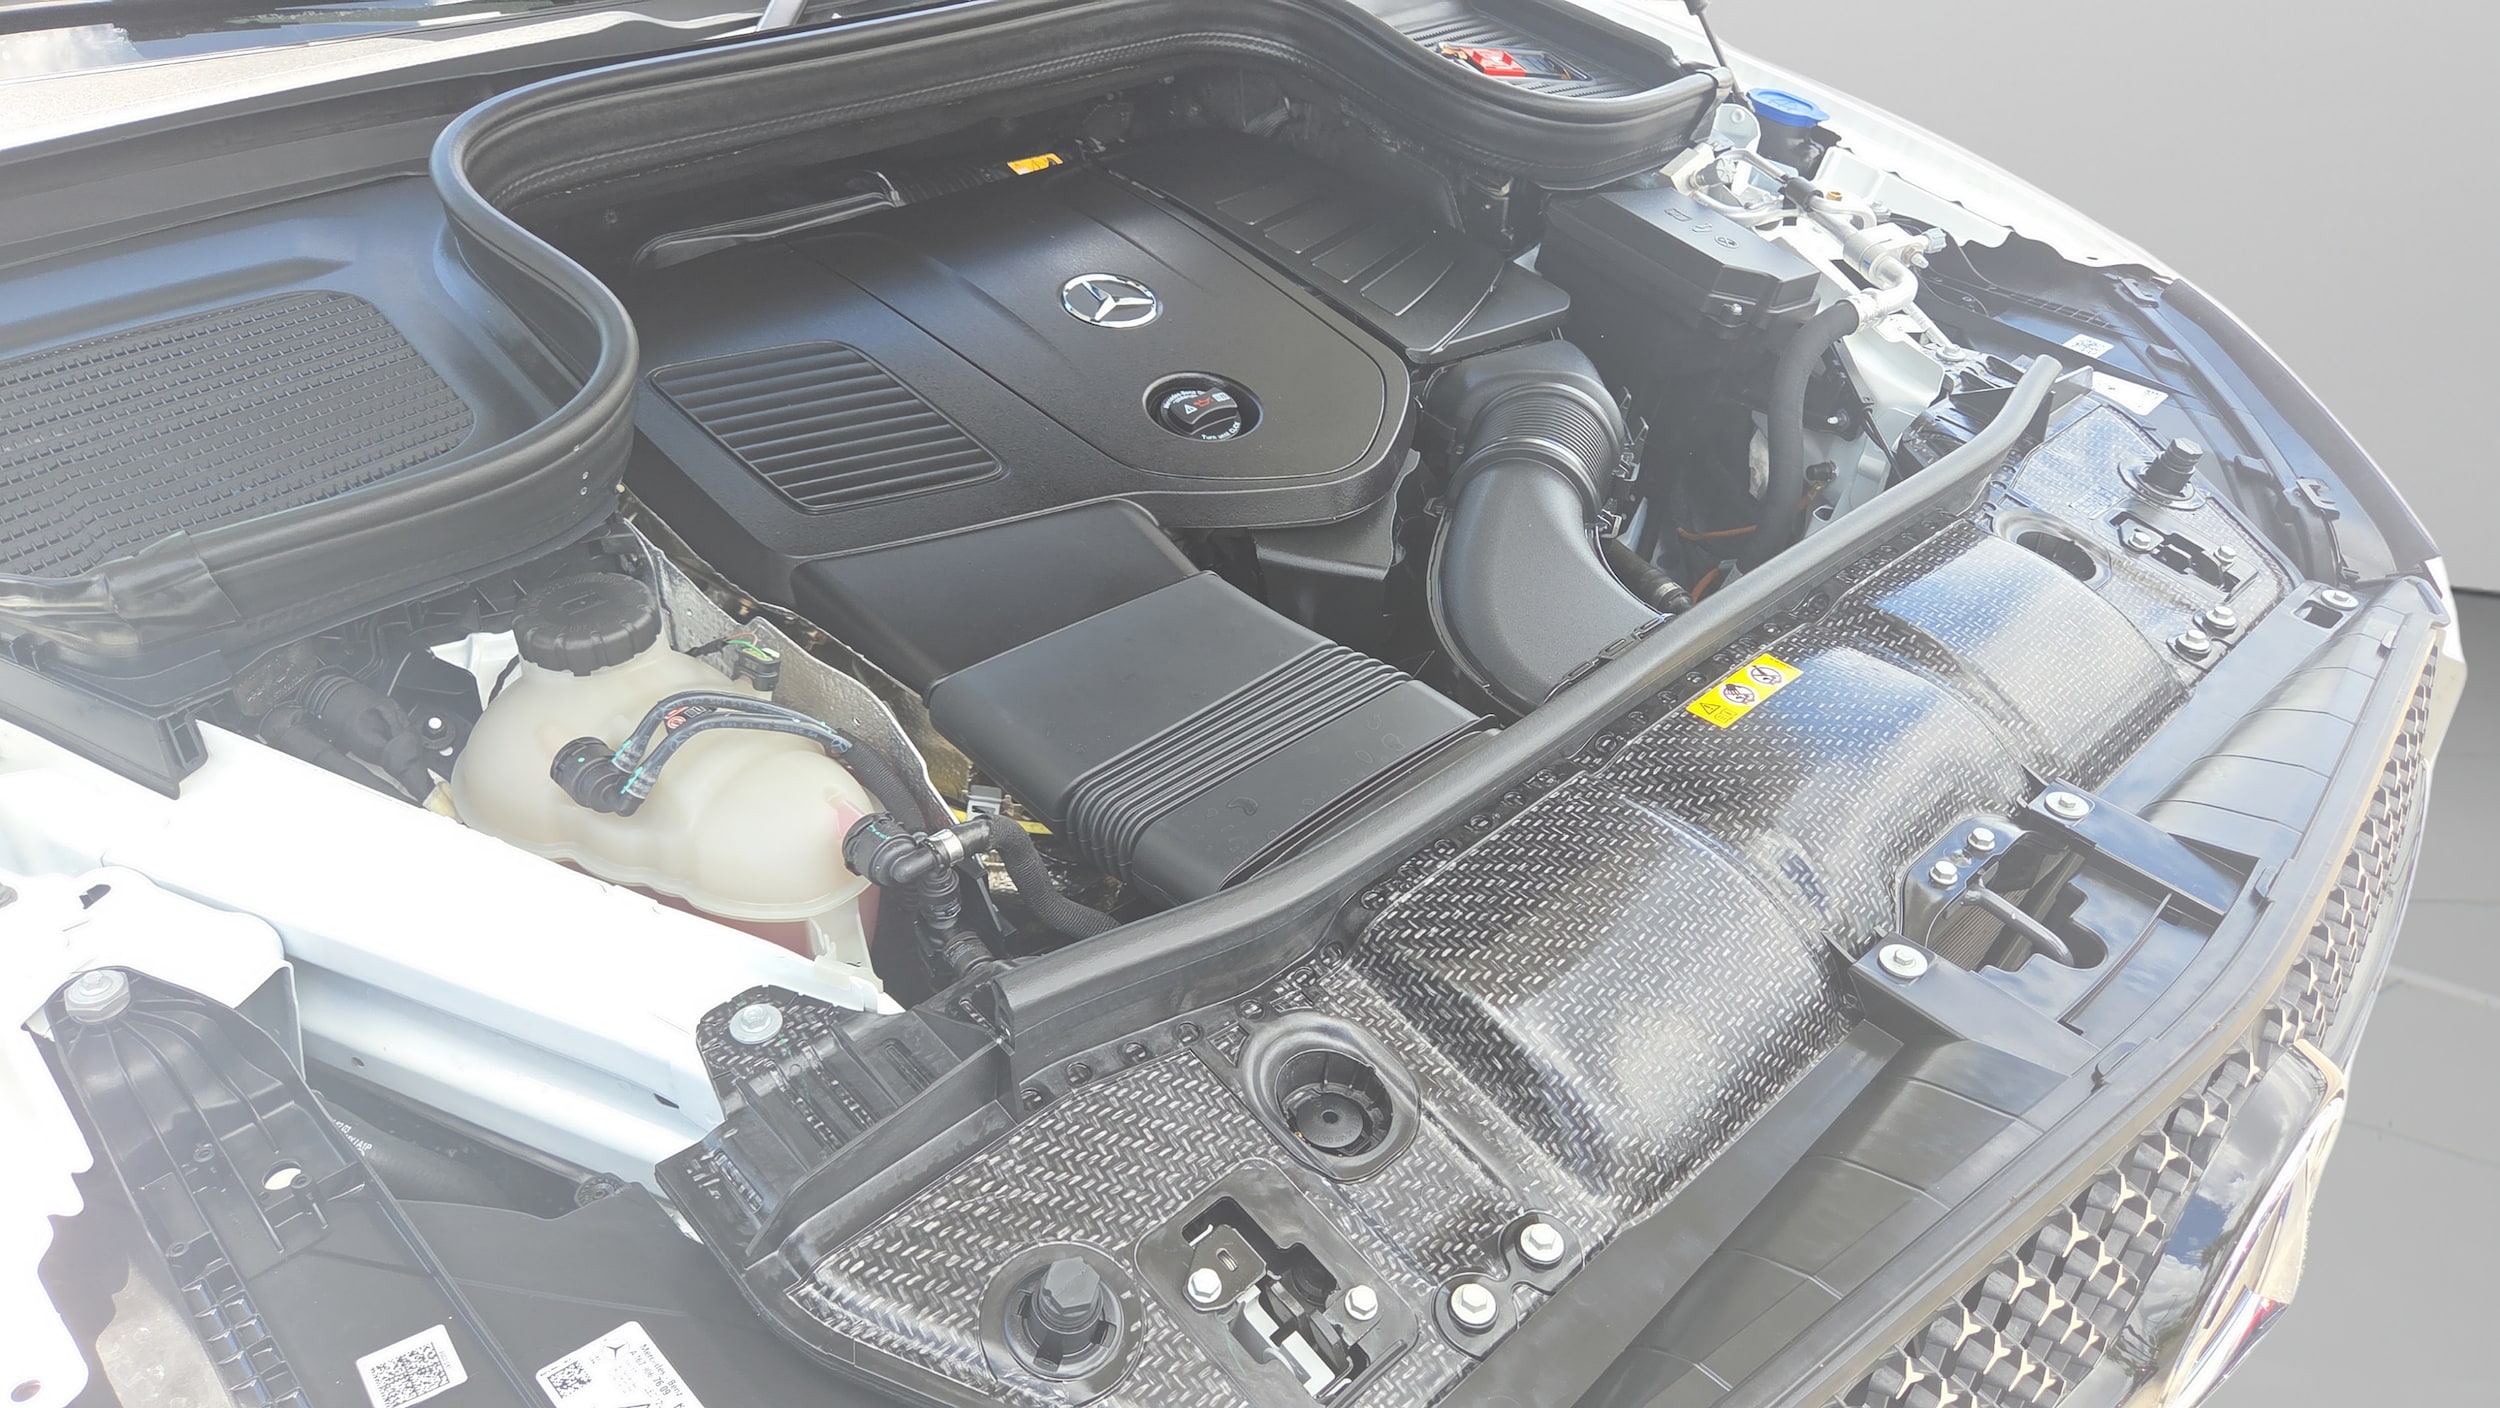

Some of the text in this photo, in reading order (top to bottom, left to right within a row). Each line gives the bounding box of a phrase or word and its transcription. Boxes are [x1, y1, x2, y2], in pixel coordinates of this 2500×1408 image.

[653, 1376, 664, 1387] 76
[659, 1385, 671, 1396] 09
[667, 1379, 683, 1397] Benz
